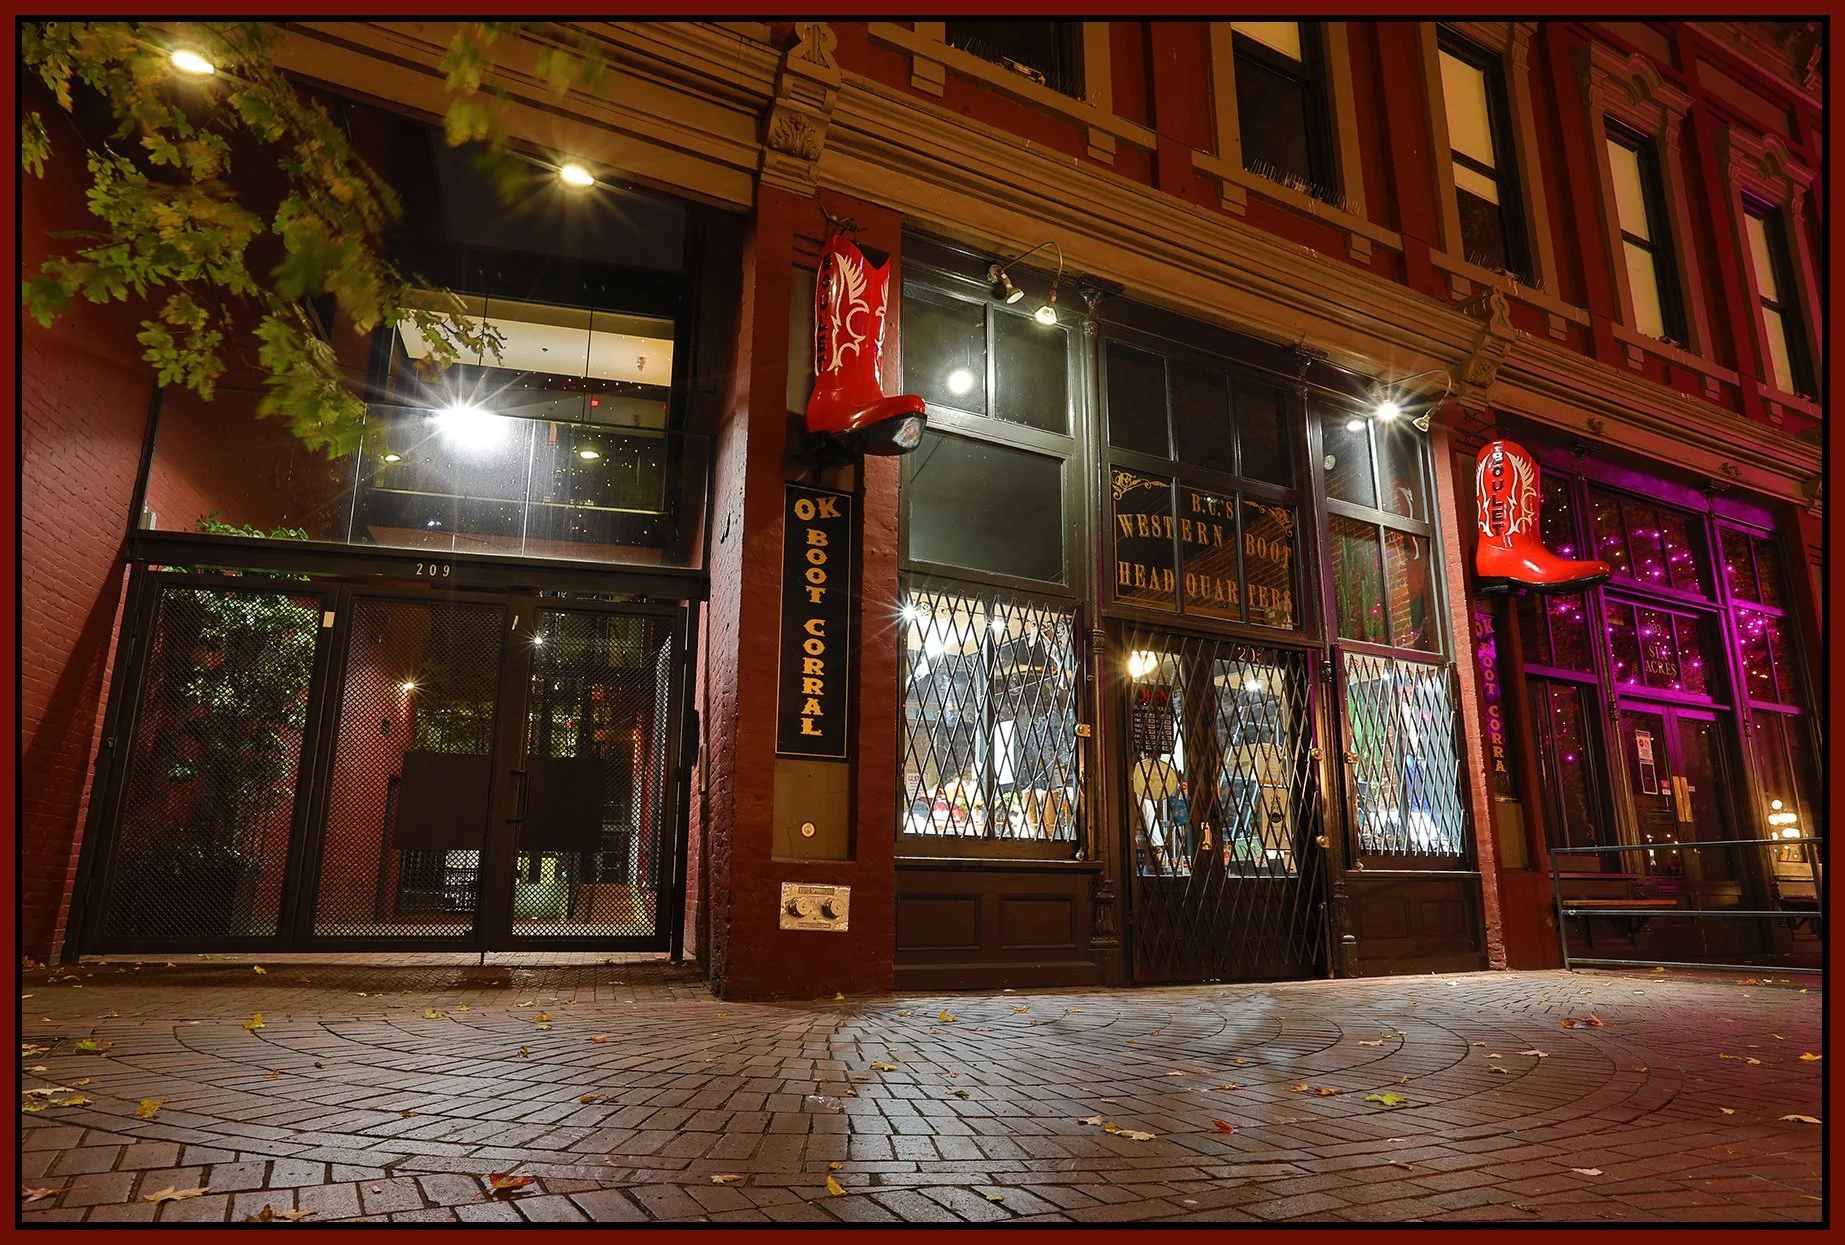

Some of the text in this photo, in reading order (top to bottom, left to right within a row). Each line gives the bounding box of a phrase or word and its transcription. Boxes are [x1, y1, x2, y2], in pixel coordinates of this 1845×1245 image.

[794, 496, 841, 521] OK
[1117, 513, 1292, 570] WESTERN BOOT
[416, 563, 450, 577] 209
[805, 528, 829, 603] BOOT
[1475, 618, 1495, 637] OK
[801, 619, 826, 736] CORRAL
[1645, 659, 1677, 677] ACRES
